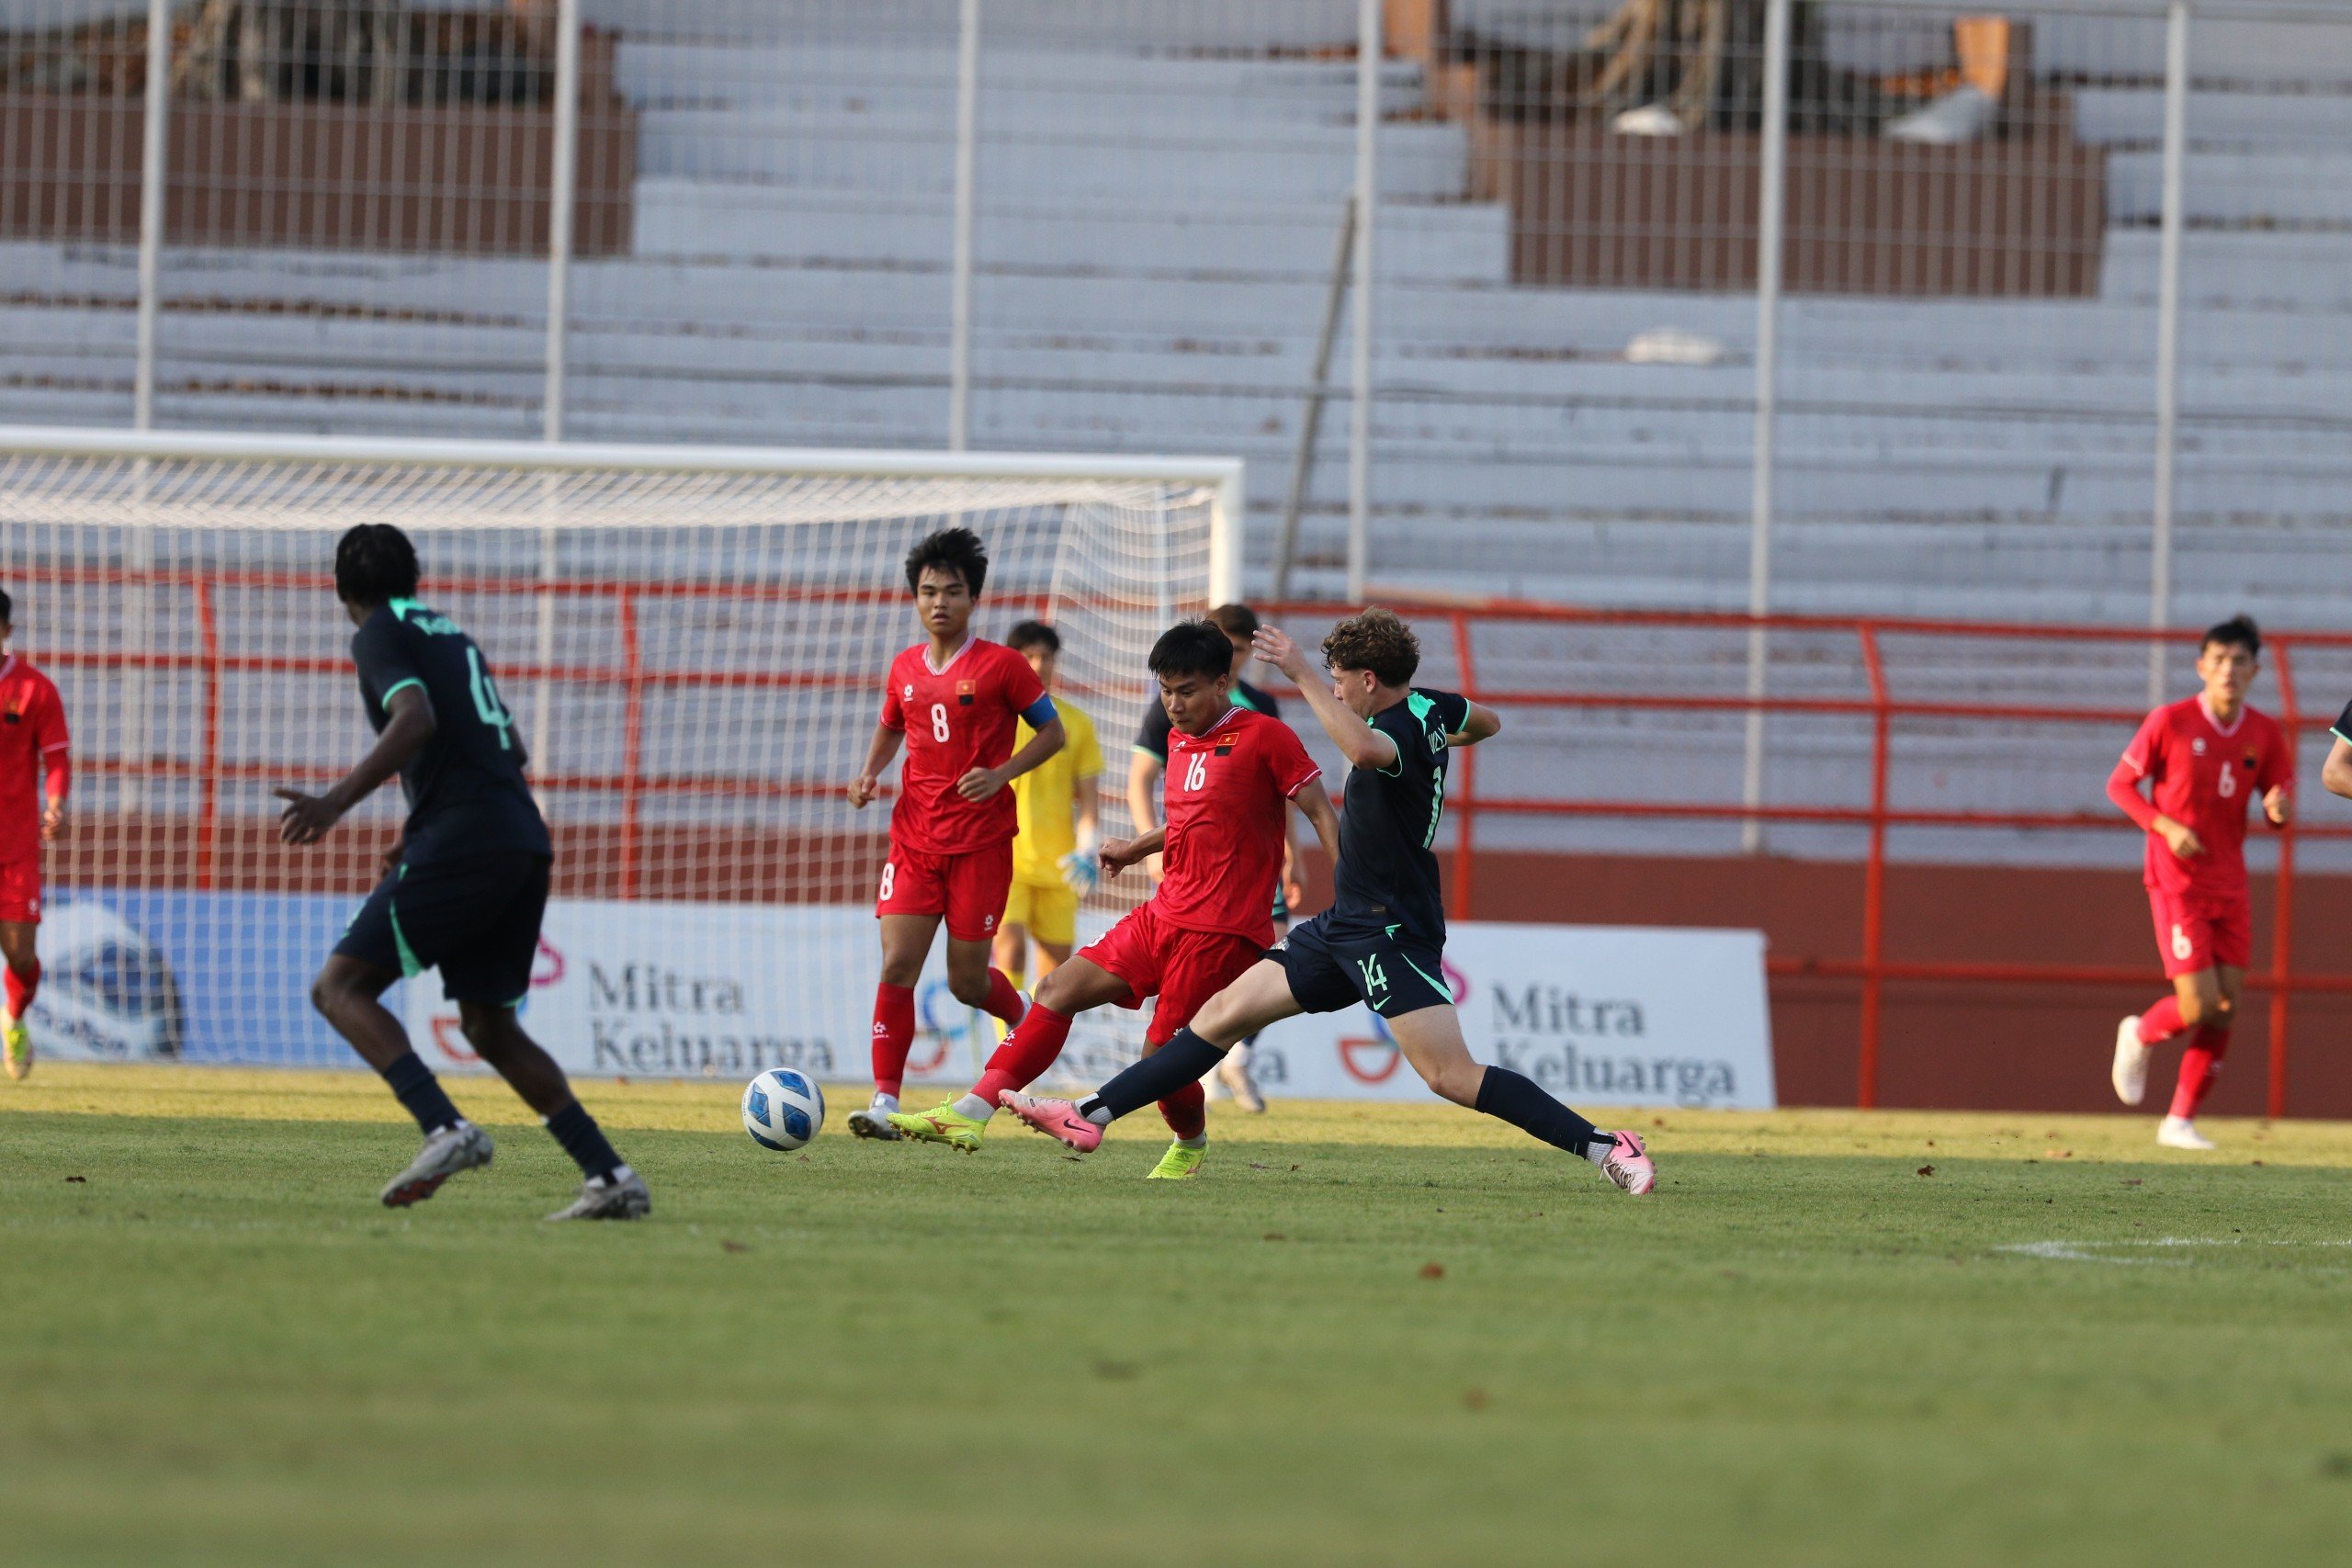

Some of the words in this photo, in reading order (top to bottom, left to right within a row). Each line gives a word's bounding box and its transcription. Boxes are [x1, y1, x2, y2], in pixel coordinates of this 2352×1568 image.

[467, 646, 514, 750] 4
[930, 703, 951, 743] 8
[1183, 751, 1206, 793] 16
[2217, 761, 2236, 798] 6
[879, 862, 896, 901] 8
[2171, 922, 2193, 960] 6
[588, 962, 746, 1015] Mitra
[1357, 953, 1388, 997] 14
[1490, 980, 1646, 1037] Mitra
[1496, 1038, 1737, 1110] Keluarga
